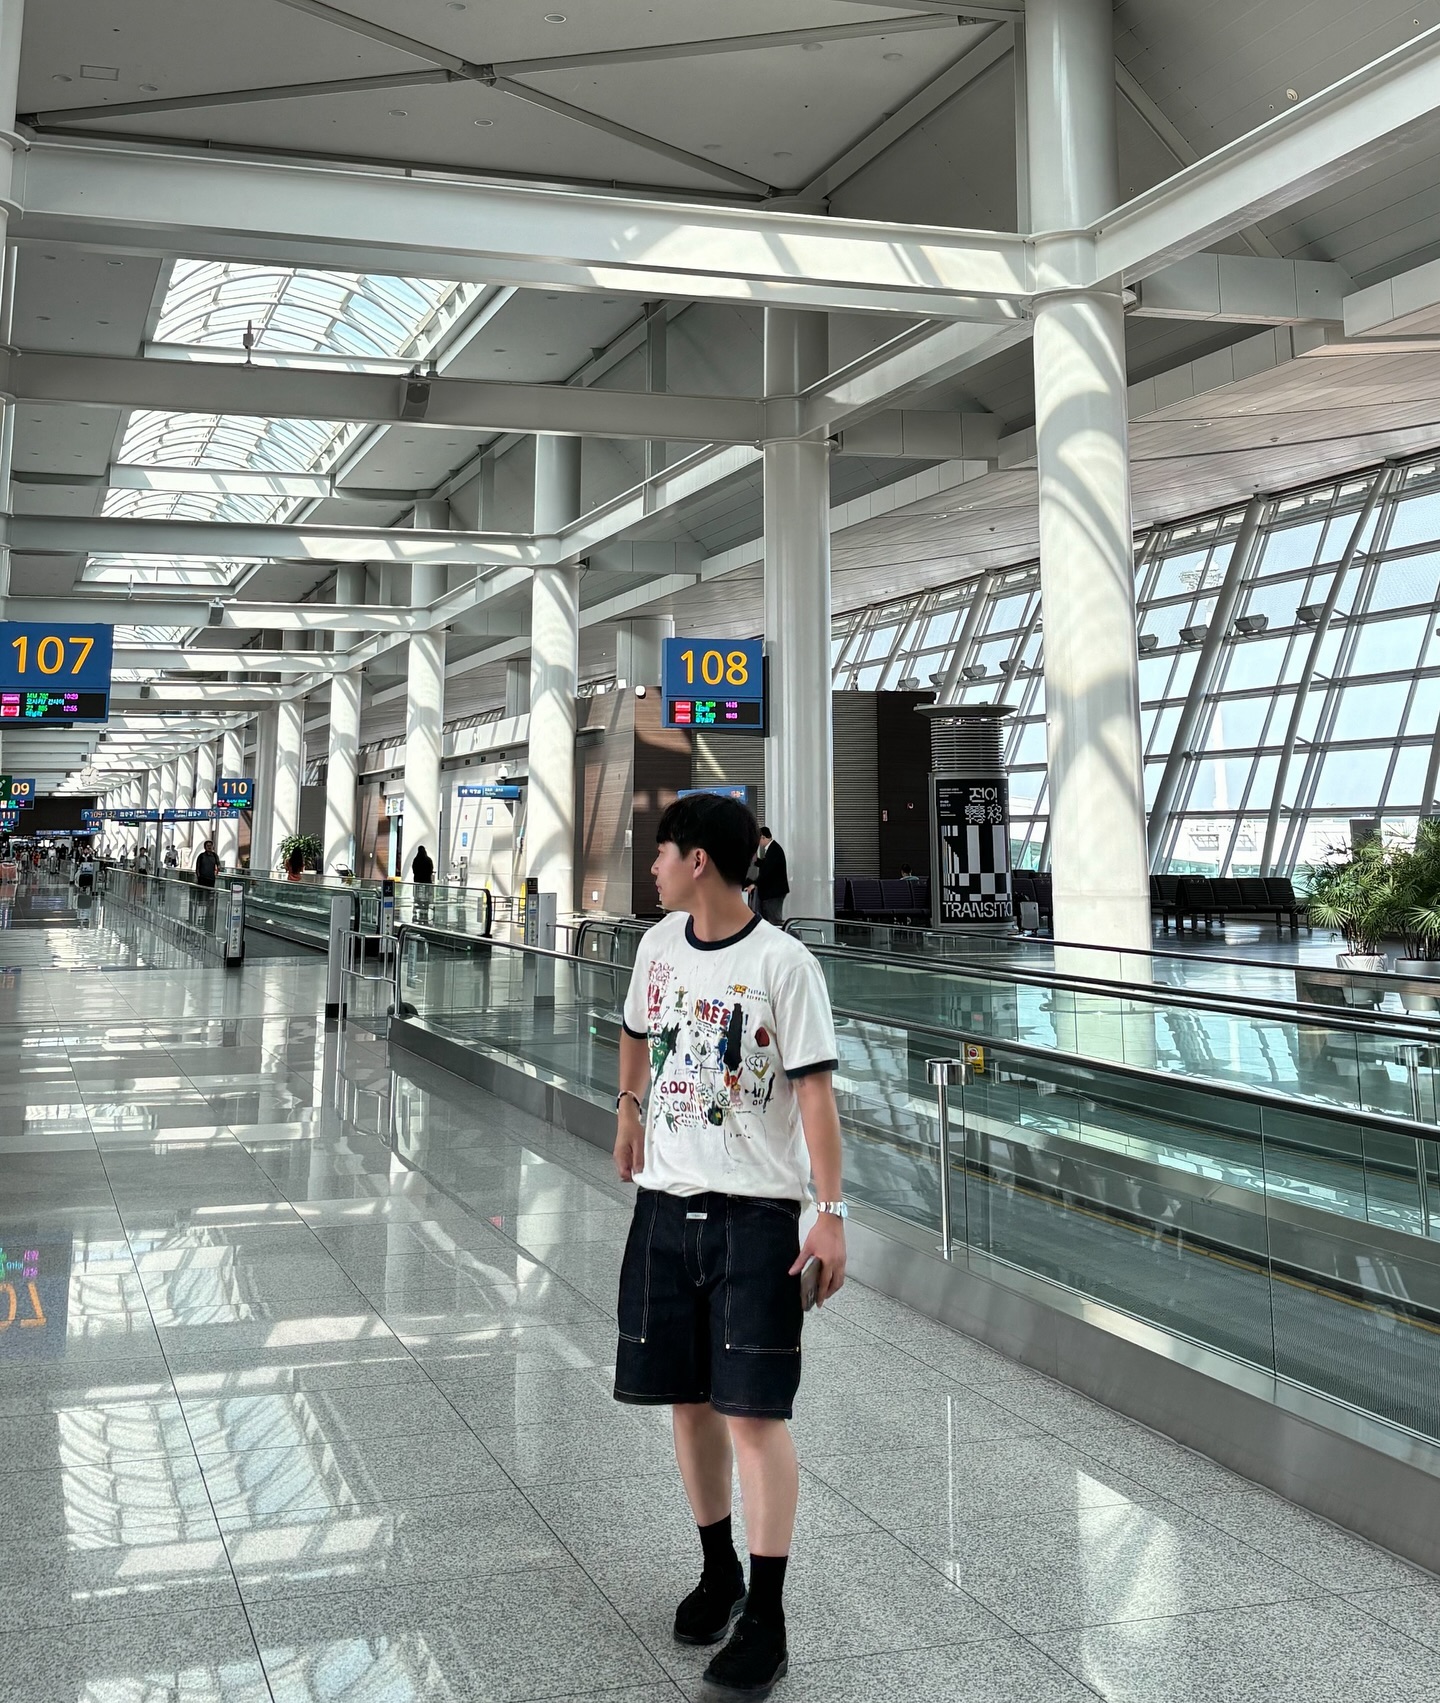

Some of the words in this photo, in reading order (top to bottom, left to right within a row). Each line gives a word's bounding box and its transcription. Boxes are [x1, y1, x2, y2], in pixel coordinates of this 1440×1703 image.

[11, 636, 95, 675] 107
[680, 650, 749, 686] 108
[222, 782, 248, 795] 110
